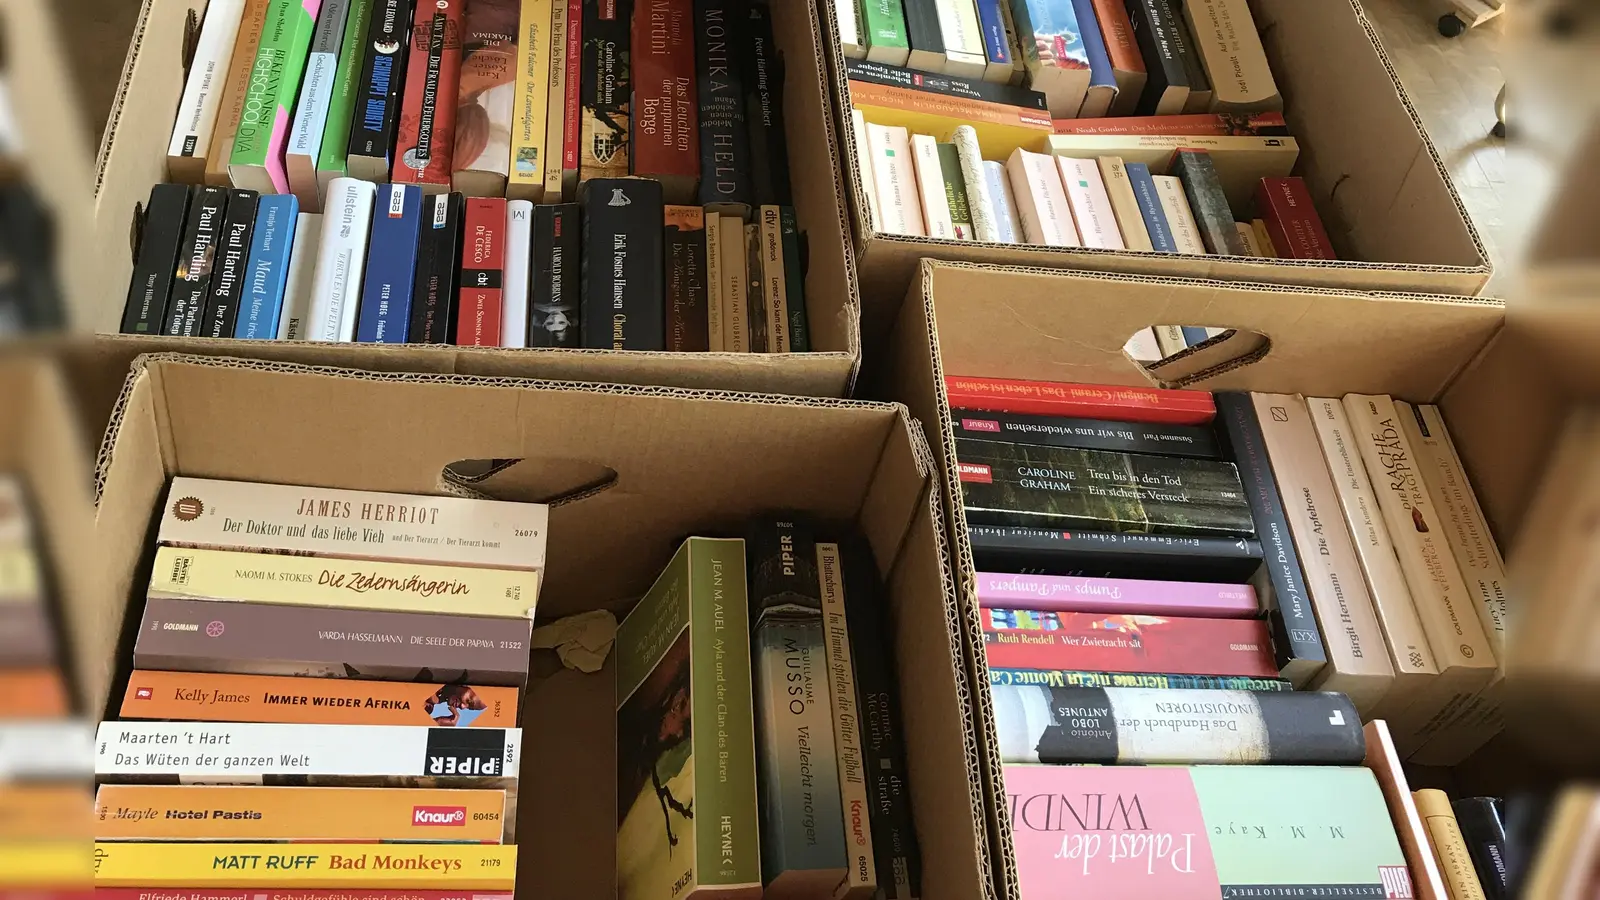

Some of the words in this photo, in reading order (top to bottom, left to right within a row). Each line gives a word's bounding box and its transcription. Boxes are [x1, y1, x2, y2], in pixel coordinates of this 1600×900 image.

[383, 8, 397, 34] LEONARD
[651, 0, 671, 55] Martini
[1150, 8, 1160, 26] Stille
[1207, 5, 1220, 28] zweiten
[471, 31, 512, 42] HAKIMA
[483, 39, 500, 47] DIE
[1156, 27, 1165, 39] der
[1215, 29, 1224, 41] den
[605, 41, 616, 73] Caroline
[705, 9, 729, 92] MONIKA
[1160, 39, 1172, 60] Nacht
[1217, 41, 1228, 53] Auf
[369, 55, 393, 98] SCHNAPPT
[857, 62, 888, 75] Epoque
[889, 68, 911, 78] Belle
[1230, 55, 1243, 79] Picoult
[241, 46, 275, 127] HIGHSCHOOL
[258, 49, 287, 130] BEKENNTNISSE
[605, 75, 616, 104] Graham
[663, 79, 675, 92] der
[676, 76, 690, 97] Das
[951, 80, 970, 89] Ross
[952, 86, 982, 98] Werner
[1238, 79, 1248, 94] Jodi
[363, 99, 387, 133] SHORTY
[639, 98, 660, 135] Berge
[660, 92, 674, 147] purpurnen
[677, 101, 692, 152] Leuchten
[1075, 126, 1097, 134] Noah
[1097, 125, 1128, 134] Gordon
[1131, 124, 1144, 132] Der
[235, 128, 256, 154] DIVA
[712, 133, 737, 194] HELD
[342, 185, 359, 225] ullstein
[198, 206, 217, 231] Paul
[764, 210, 778, 226] dtv
[228, 222, 247, 247] Paul
[476, 225, 486, 236] DE
[613, 233, 627, 250] Erik
[473, 237, 485, 263] CESCO
[483, 230, 493, 260] FEDERICA
[184, 233, 212, 283] Harding
[552, 246, 563, 275] HAROLD
[613, 251, 627, 278] Fosnes
[687, 243, 698, 277] Loretta
[215, 247, 241, 297] Harding
[477, 272, 489, 287] cbt
[551, 275, 562, 303] ROBBINS
[613, 279, 627, 309] Hansen
[687, 279, 701, 308] Chase
[730, 276, 742, 315] SEBASTIAN
[177, 299, 187, 310] der
[217, 304, 228, 318] Der
[476, 294, 486, 310] ZWEI
[170, 311, 184, 335] Toten
[212, 318, 225, 339] Zorn
[475, 310, 485, 336] SONNEN
[612, 314, 627, 341] Choral
[1017, 466, 1077, 481] CAROLINE
[1371, 433, 1405, 492] RACHE
[1019, 478, 1071, 492] GRAHAM
[1086, 468, 1111, 482] Treu
[1112, 470, 1129, 483] bis
[1130, 472, 1140, 484] in
[1141, 472, 1159, 486] den
[1161, 474, 1182, 488] Tod
[1087, 485, 1106, 498] Ein
[1108, 486, 1147, 501] sicheres
[1148, 489, 1190, 504] Versteck
[1400, 491, 1412, 511] DIE
[297, 498, 352, 520] JAMES
[361, 502, 439, 526] HERRIOT
[1302, 487, 1323, 534] Apfelrose
[514, 529, 539, 539] 26079
[1270, 521, 1287, 563] Davidson
[780, 534, 796, 576] PIPER
[1317, 537, 1331, 557] Die
[234, 569, 265, 582] NAOMI
[266, 571, 278, 582] M.
[279, 571, 313, 584] STOKES
[318, 569, 343, 589] Die
[345, 571, 470, 599] Zedernsängerin
[989, 578, 1049, 597] Pampers
[1054, 581, 1073, 594] und
[1284, 565, 1298, 593] Janice
[1075, 583, 1122, 600] Pumps
[1330, 572, 1352, 623] Hermann
[1292, 594, 1304, 619] Mary
[162, 621, 199, 632] GOLDMANN
[318, 630, 346, 642] VARDA
[347, 632, 403, 645] HASSELMANN
[409, 635, 424, 646] DIE
[425, 636, 447, 648] SEELE
[448, 637, 465, 648] DER
[466, 638, 495, 650] PAPAYA
[499, 640, 522, 650] 21522
[996, 632, 1020, 645] Ruth
[1020, 634, 1055, 647] Rendell
[1061, 635, 1080, 647] Wer
[1080, 635, 1129, 649] Zwietracht
[1129, 637, 1143, 649] sät
[1229, 643, 1260, 653] GOLDMANN
[1346, 624, 1363, 659] Birgit
[784, 637, 804, 716] MUSSO
[801, 648, 815, 705] GUILLAUME
[174, 686, 210, 706] Kelly
[210, 689, 251, 705] James
[263, 692, 308, 706] IMMER
[312, 696, 361, 709] WIEDER
[364, 696, 411, 711] AFRIKA
[1154, 702, 1254, 715] INQUISITOREN
[1058, 707, 1109, 718] ANTUNES
[1070, 718, 1101, 729] LOBO
[1119, 719, 1140, 732] der
[1144, 718, 1210, 733] Handbuch
[1212, 719, 1237, 731] Das
[118, 731, 178, 745] Maarten
[199, 731, 231, 746] Hart
[114, 752, 139, 767] Das
[145, 752, 192, 767] Wüten
[195, 753, 219, 767] der
[224, 756, 274, 769] ganzen
[280, 754, 310, 768] Welt
[505, 742, 514, 764] 2592
[797, 724, 814, 788] Vielleicht
[429, 756, 495, 775] PIPER
[876, 775, 893, 816] straße
[889, 775, 902, 797] die
[112, 807, 159, 823] Mayle
[165, 809, 208, 821] Hotel
[212, 809, 262, 821] Pastis
[472, 812, 499, 822] 60454
[802, 792, 818, 847] morgen
[212, 855, 262, 870] MATT
[265, 855, 320, 870] RUFF
[328, 854, 367, 871] Bad
[371, 854, 463, 876] Monkeys
[480, 858, 501, 868] 21179
[1053, 833, 1101, 877] der
[1107, 832, 1197, 876] Palast
[857, 855, 869, 882] 65025
